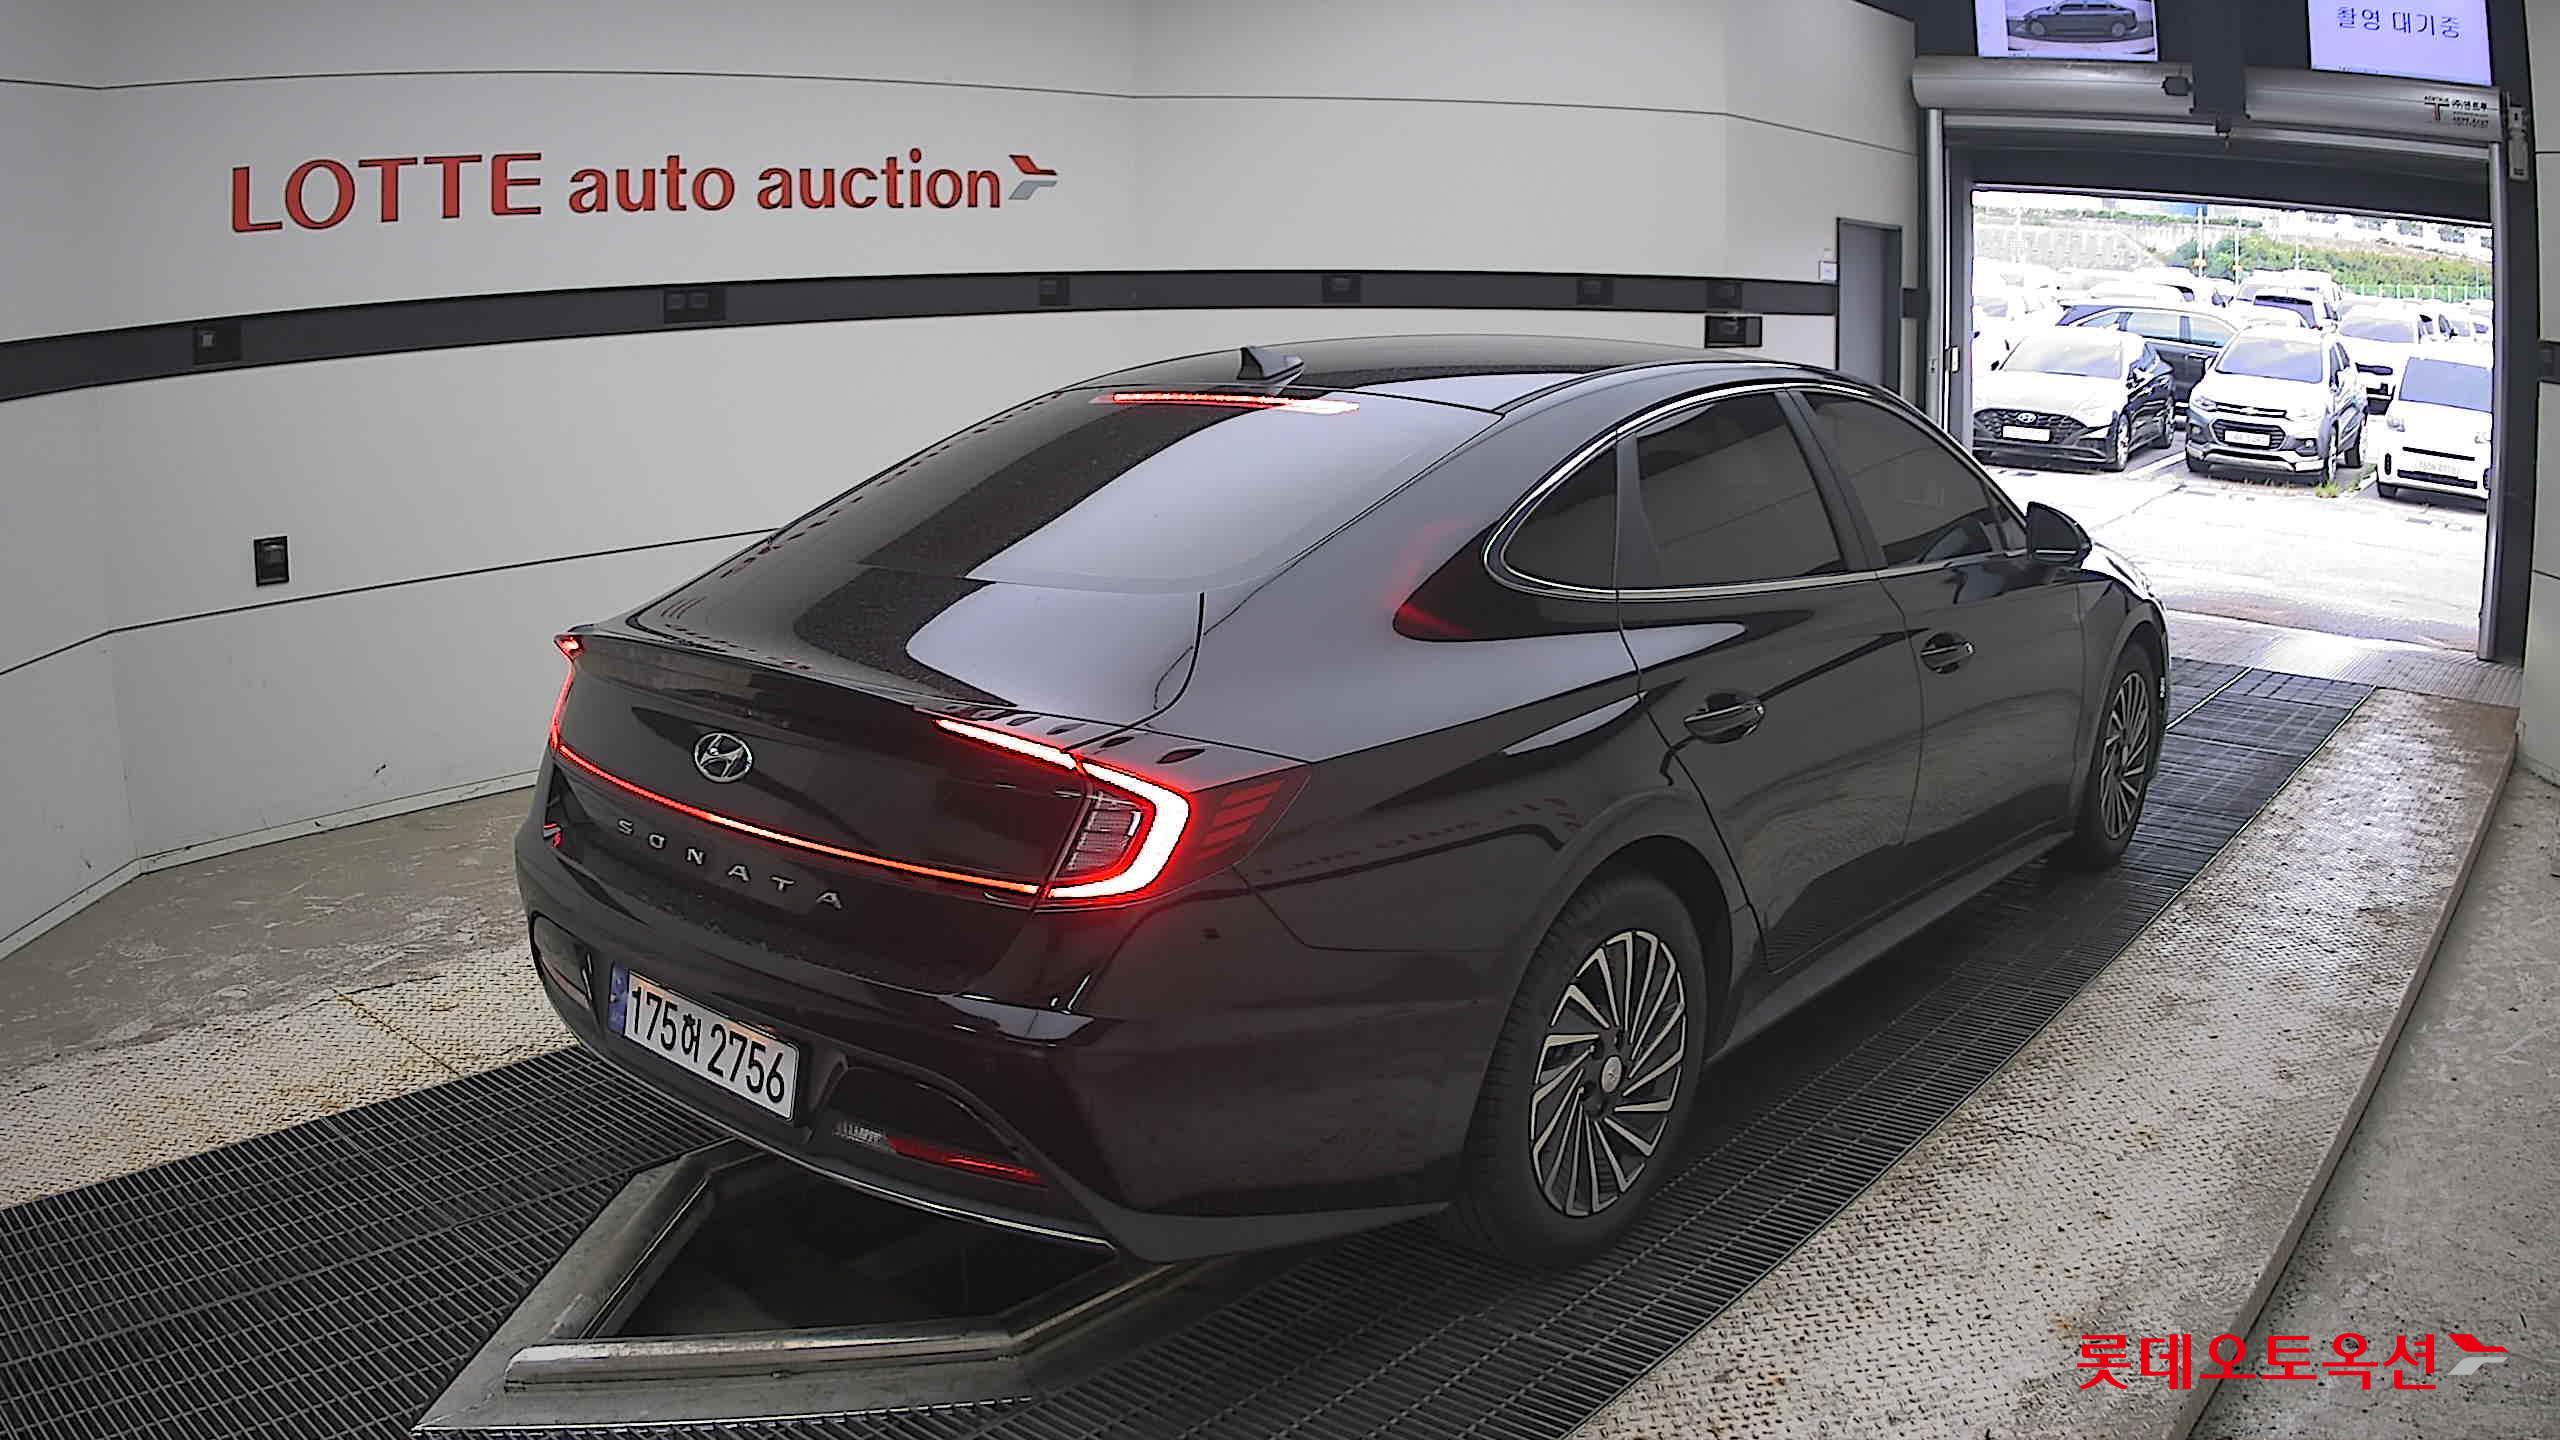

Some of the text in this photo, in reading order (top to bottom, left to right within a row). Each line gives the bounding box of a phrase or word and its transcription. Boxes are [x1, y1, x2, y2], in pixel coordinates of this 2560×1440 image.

[2337, 6, 2460, 39] 촬영 대기중
[232, 147, 1002, 232] LOTTE auto auction
[617, 818, 843, 910] SONATA
[632, 986, 785, 1104] 175허 2756
